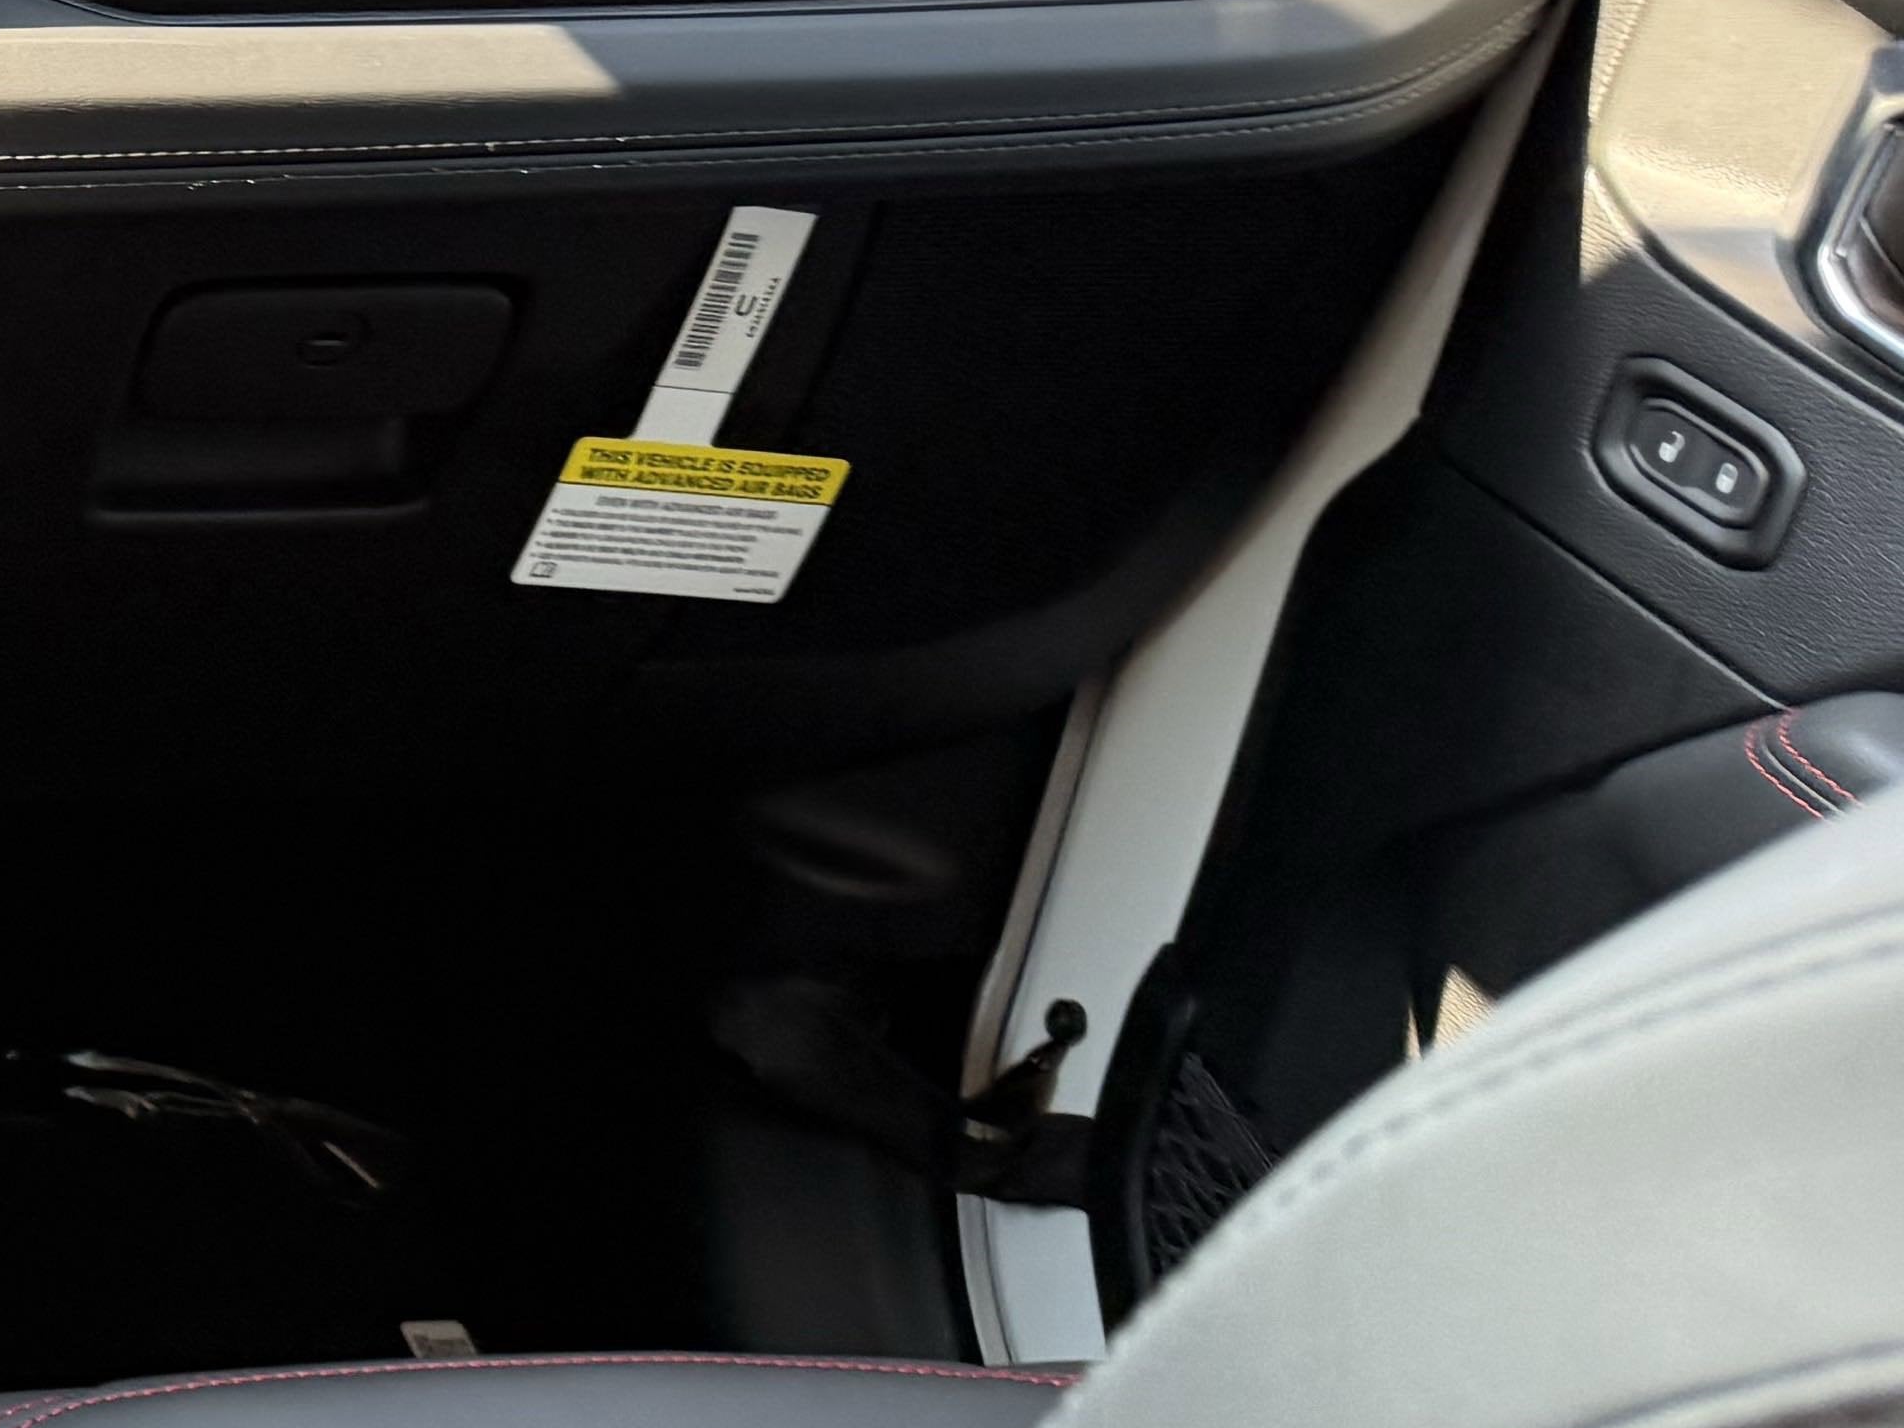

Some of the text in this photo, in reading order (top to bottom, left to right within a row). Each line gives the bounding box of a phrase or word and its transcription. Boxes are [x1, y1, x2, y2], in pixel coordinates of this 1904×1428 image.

[590, 448, 633, 465] THIS
[635, 451, 717, 472] VEHICLE
[739, 460, 832, 481] EQUIPPED
[581, 466, 823, 499] WITH ADVANCED AIR BAGS
